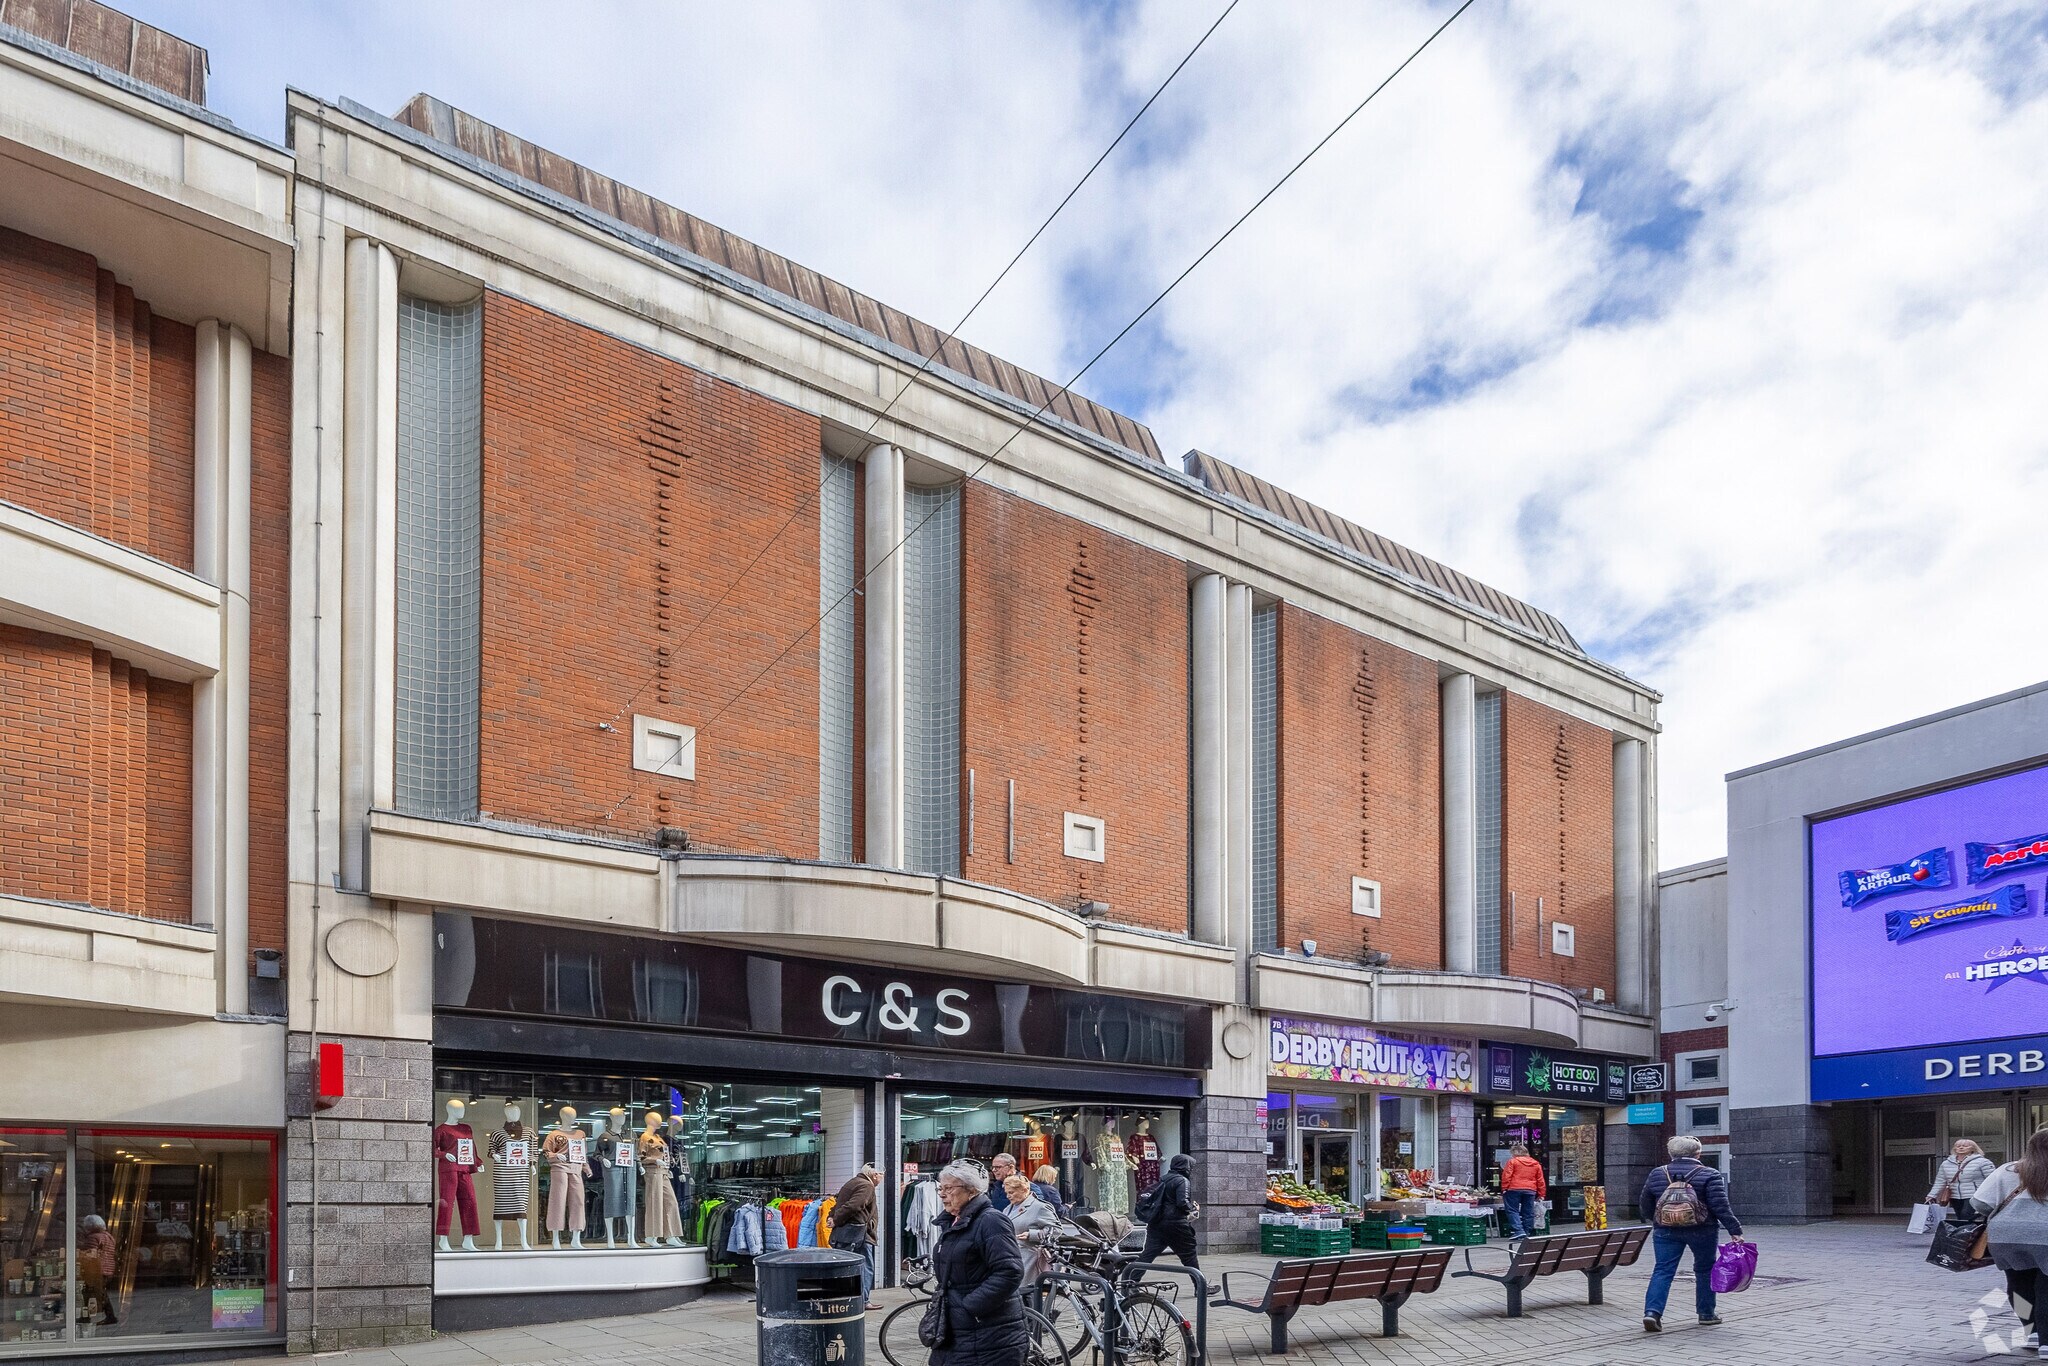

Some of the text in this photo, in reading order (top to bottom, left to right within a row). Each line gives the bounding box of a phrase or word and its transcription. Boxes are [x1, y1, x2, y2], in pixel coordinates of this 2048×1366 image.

[1857, 871, 1891, 885] KING
[1858, 873, 1911, 892] ARTHUR
[1910, 901, 1997, 928] Sir Gawain
[1272, 1021, 1282, 1029] 7B
[1272, 1031, 1471, 1080] DERBY FRUIT & VEG
[1925, 1050, 2045, 1081] DERB
[1494, 1077, 1510, 1085] STORE
[1609, 1075, 1623, 1085] Vape
[1557, 1084, 1594, 1093] DERBY
[820, 1304, 849, 1314] Litter
